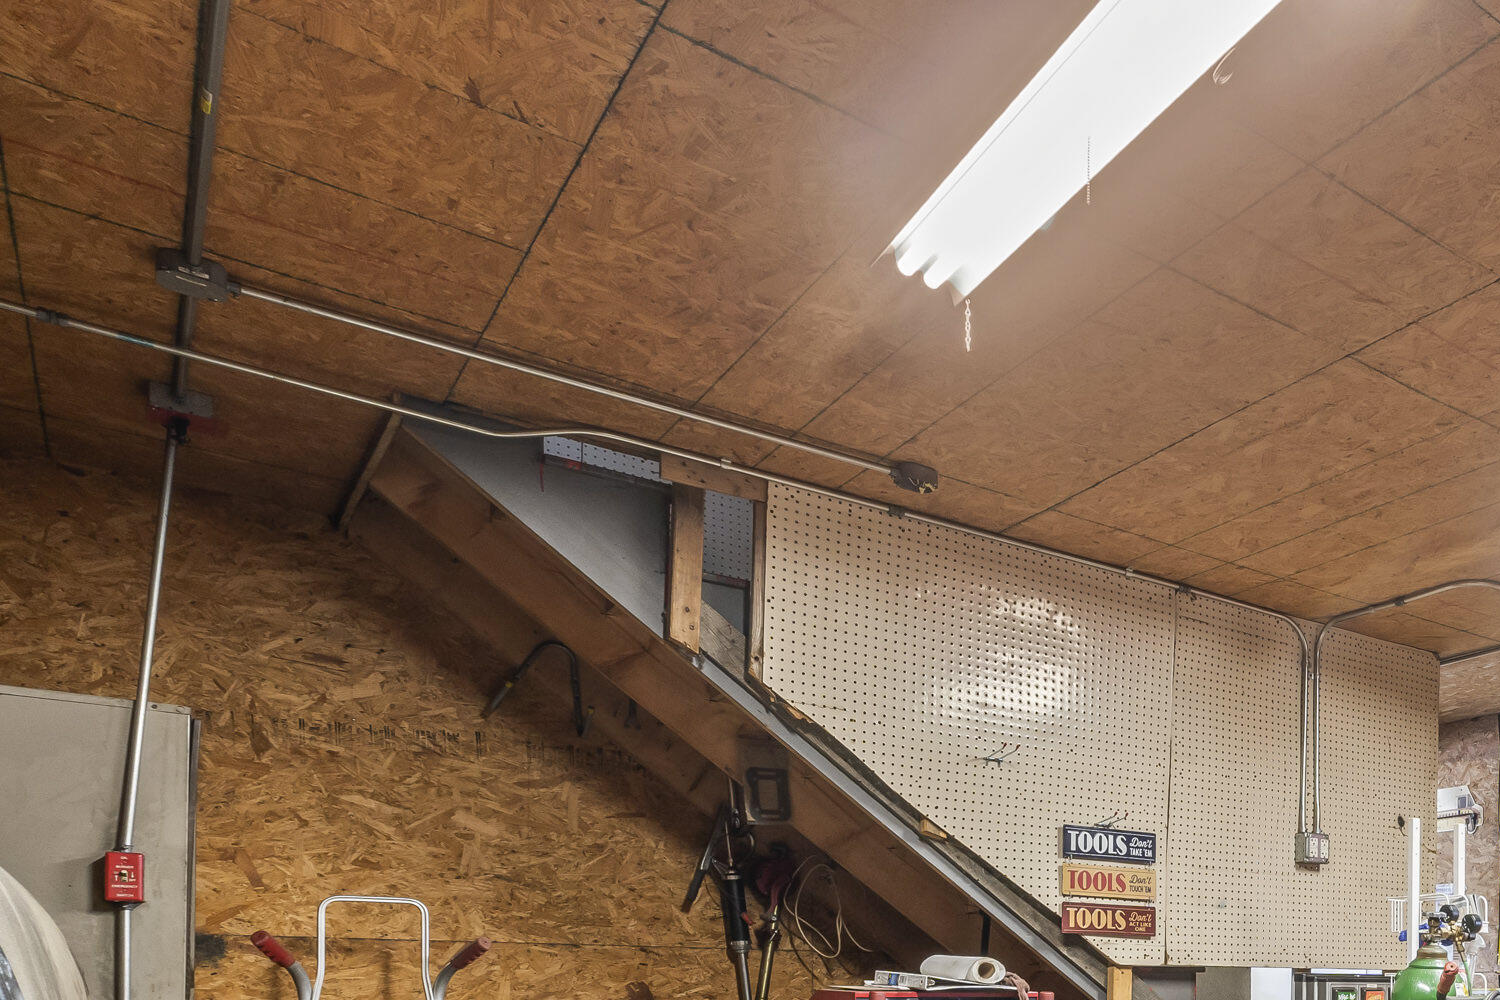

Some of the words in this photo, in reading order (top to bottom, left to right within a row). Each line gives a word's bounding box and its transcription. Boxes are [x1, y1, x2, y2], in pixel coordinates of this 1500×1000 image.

[1067, 830, 1128, 856] TOOLS
[1129, 837, 1153, 848] Don't
[1129, 848, 1143, 857] TAKE
[1067, 869, 1127, 893] TOOLS
[1129, 874, 1152, 884] Don't
[1129, 884, 1144, 893] TOUCH
[1066, 907, 1127, 931] TOOLS
[1128, 911, 1152, 922] Don't
